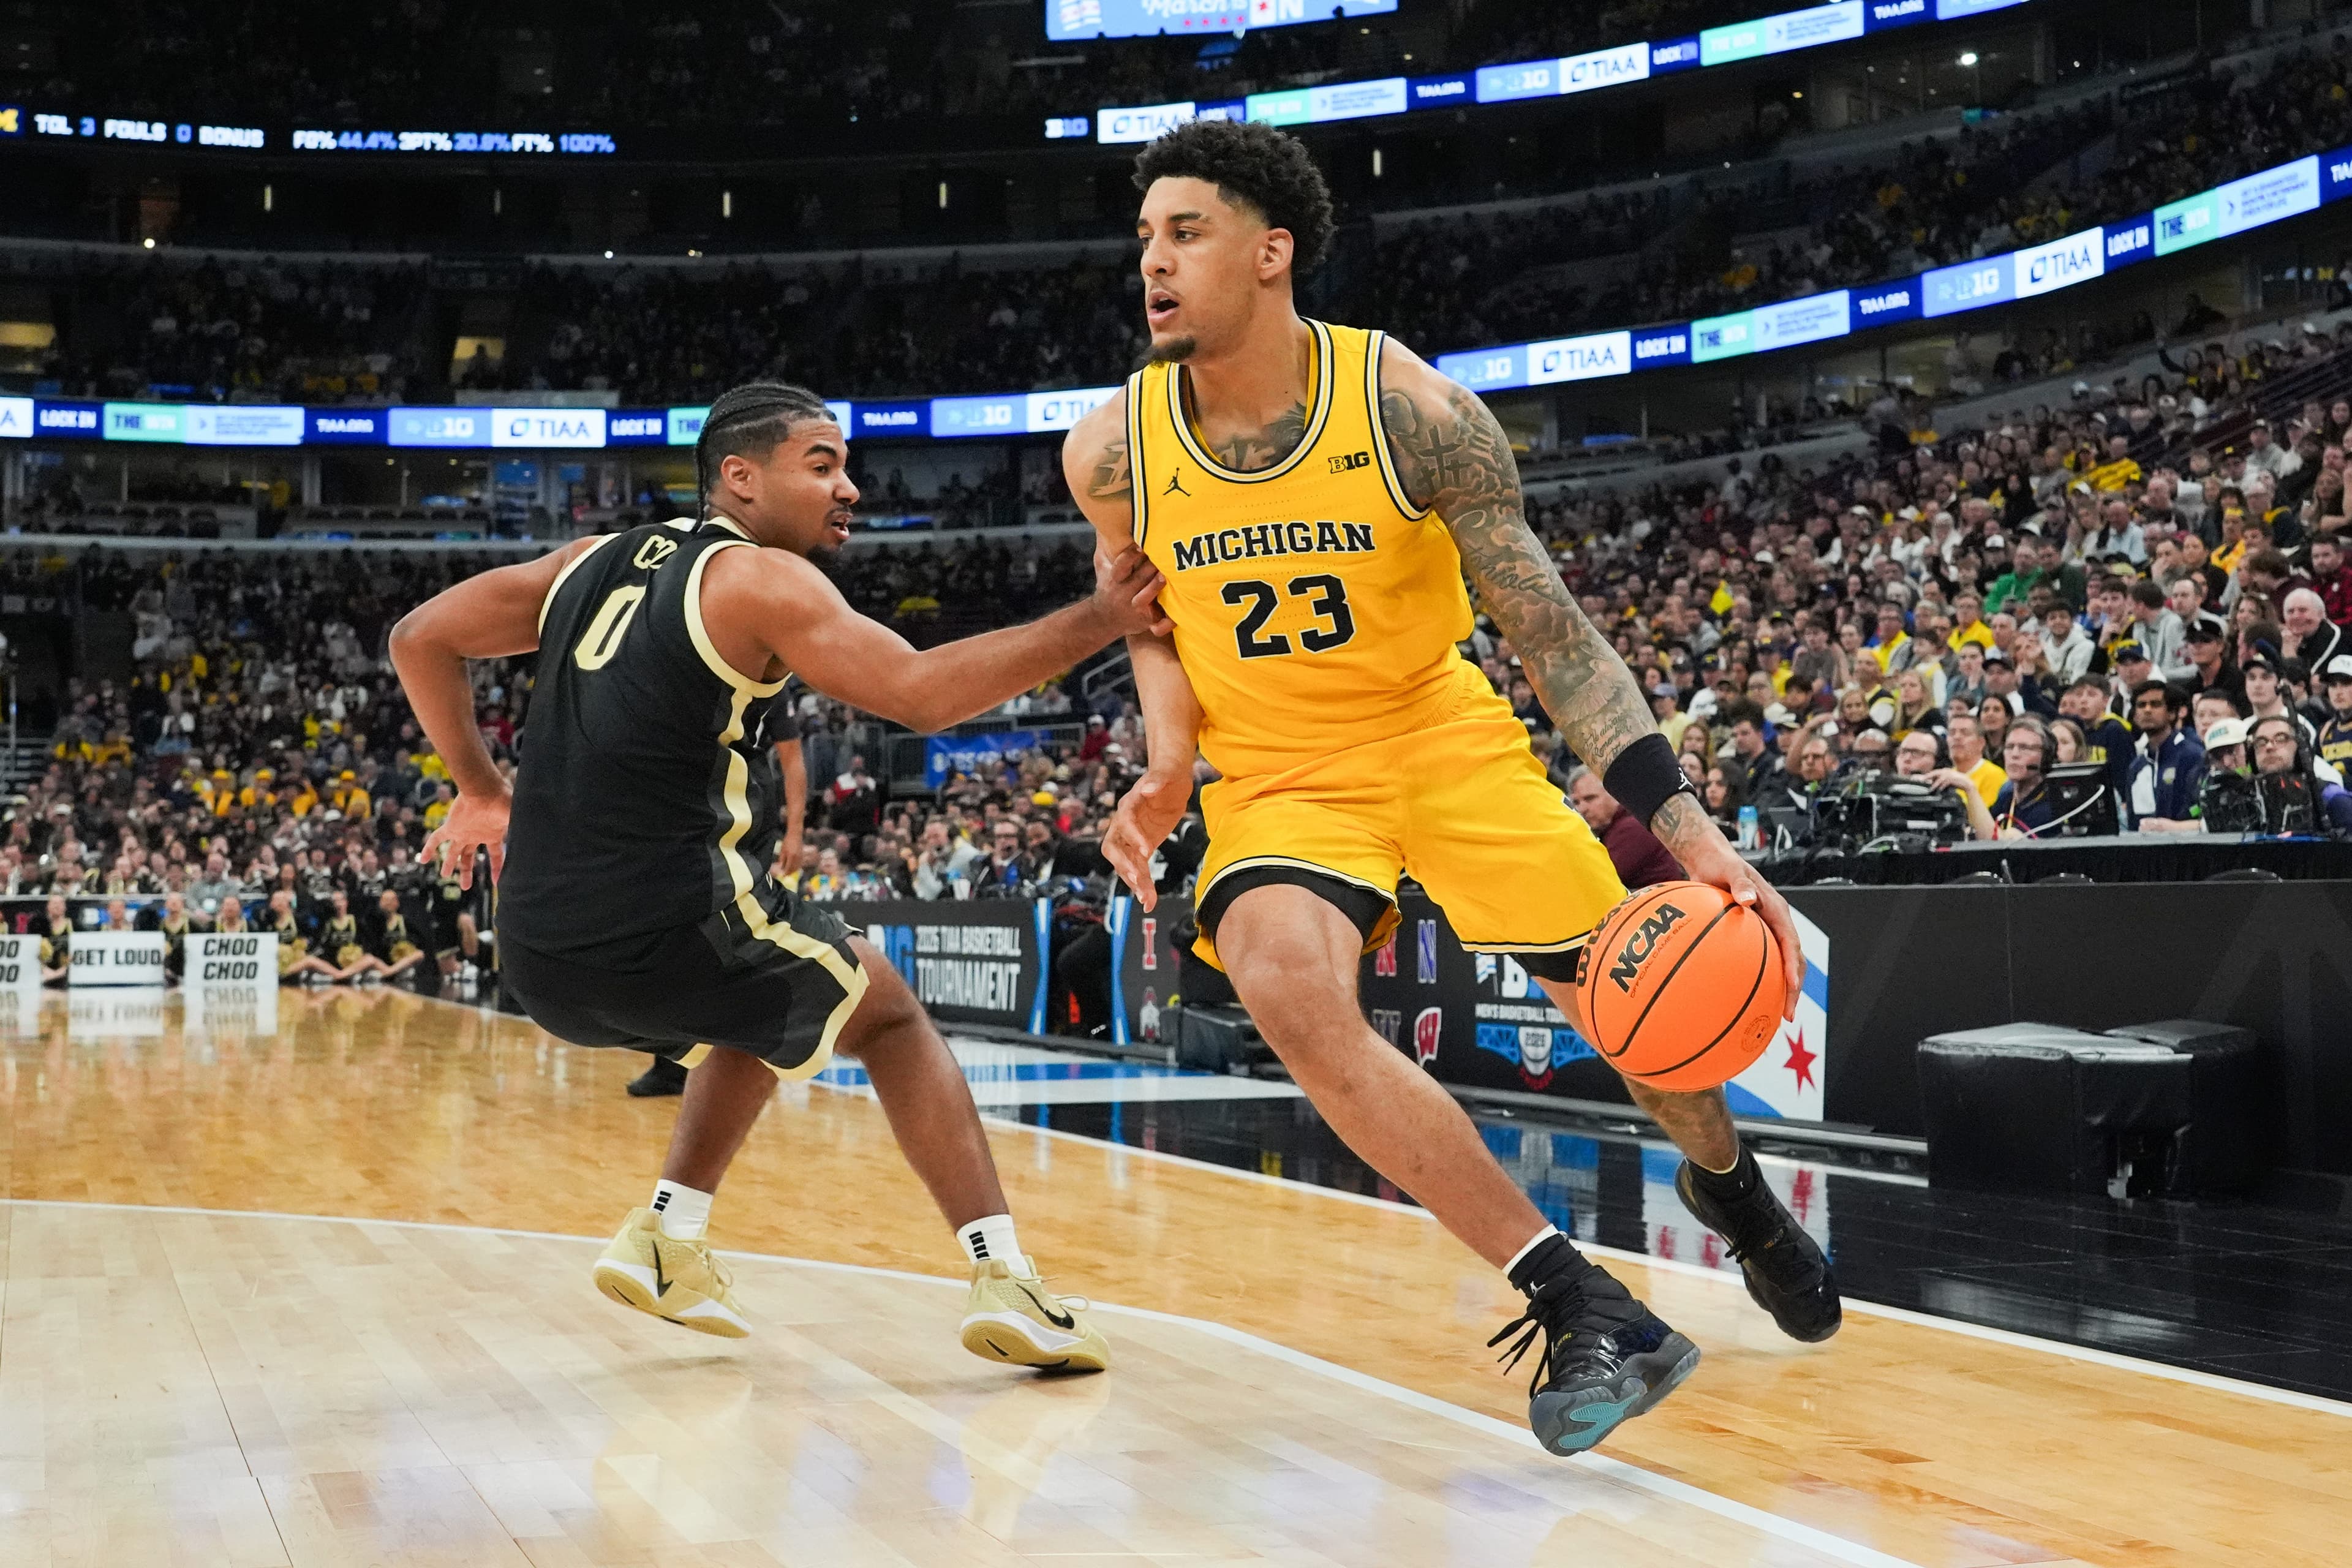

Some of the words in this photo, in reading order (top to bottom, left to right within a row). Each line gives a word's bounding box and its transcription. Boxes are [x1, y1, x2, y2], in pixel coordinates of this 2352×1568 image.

[1594, 55, 1637, 78] TIAA
[104, 119, 167, 141] FOULS
[199, 126, 264, 148] BONUS
[512, 134, 554, 152] FT%
[560, 134, 615, 152] 100%
[2108, 229, 2135, 257] LOCK
[2135, 225, 2150, 249] IN
[2052, 246, 2092, 281] TIAA
[1567, 346, 1616, 370] TIAA
[1636, 336, 1668, 358] LOCK
[1669, 334, 1686, 354] IN
[40, 409, 77, 428] LOCK
[78, 410, 97, 428] IN
[536, 420, 590, 438] TIAA
[1172, 522, 1376, 571] MICHIGAN
[574, 585, 647, 671] 0
[1219, 573, 1357, 660] 23
[203, 938, 258, 956] CHOO
[962, 925, 1022, 957] BASKETBALL
[1609, 902, 1687, 994] NCAA
[72, 949, 105, 965] GET
[115, 949, 161, 966] LOUD
[203, 962, 258, 981] CHOO
[916, 958, 1022, 1012] TOURNAMENT
